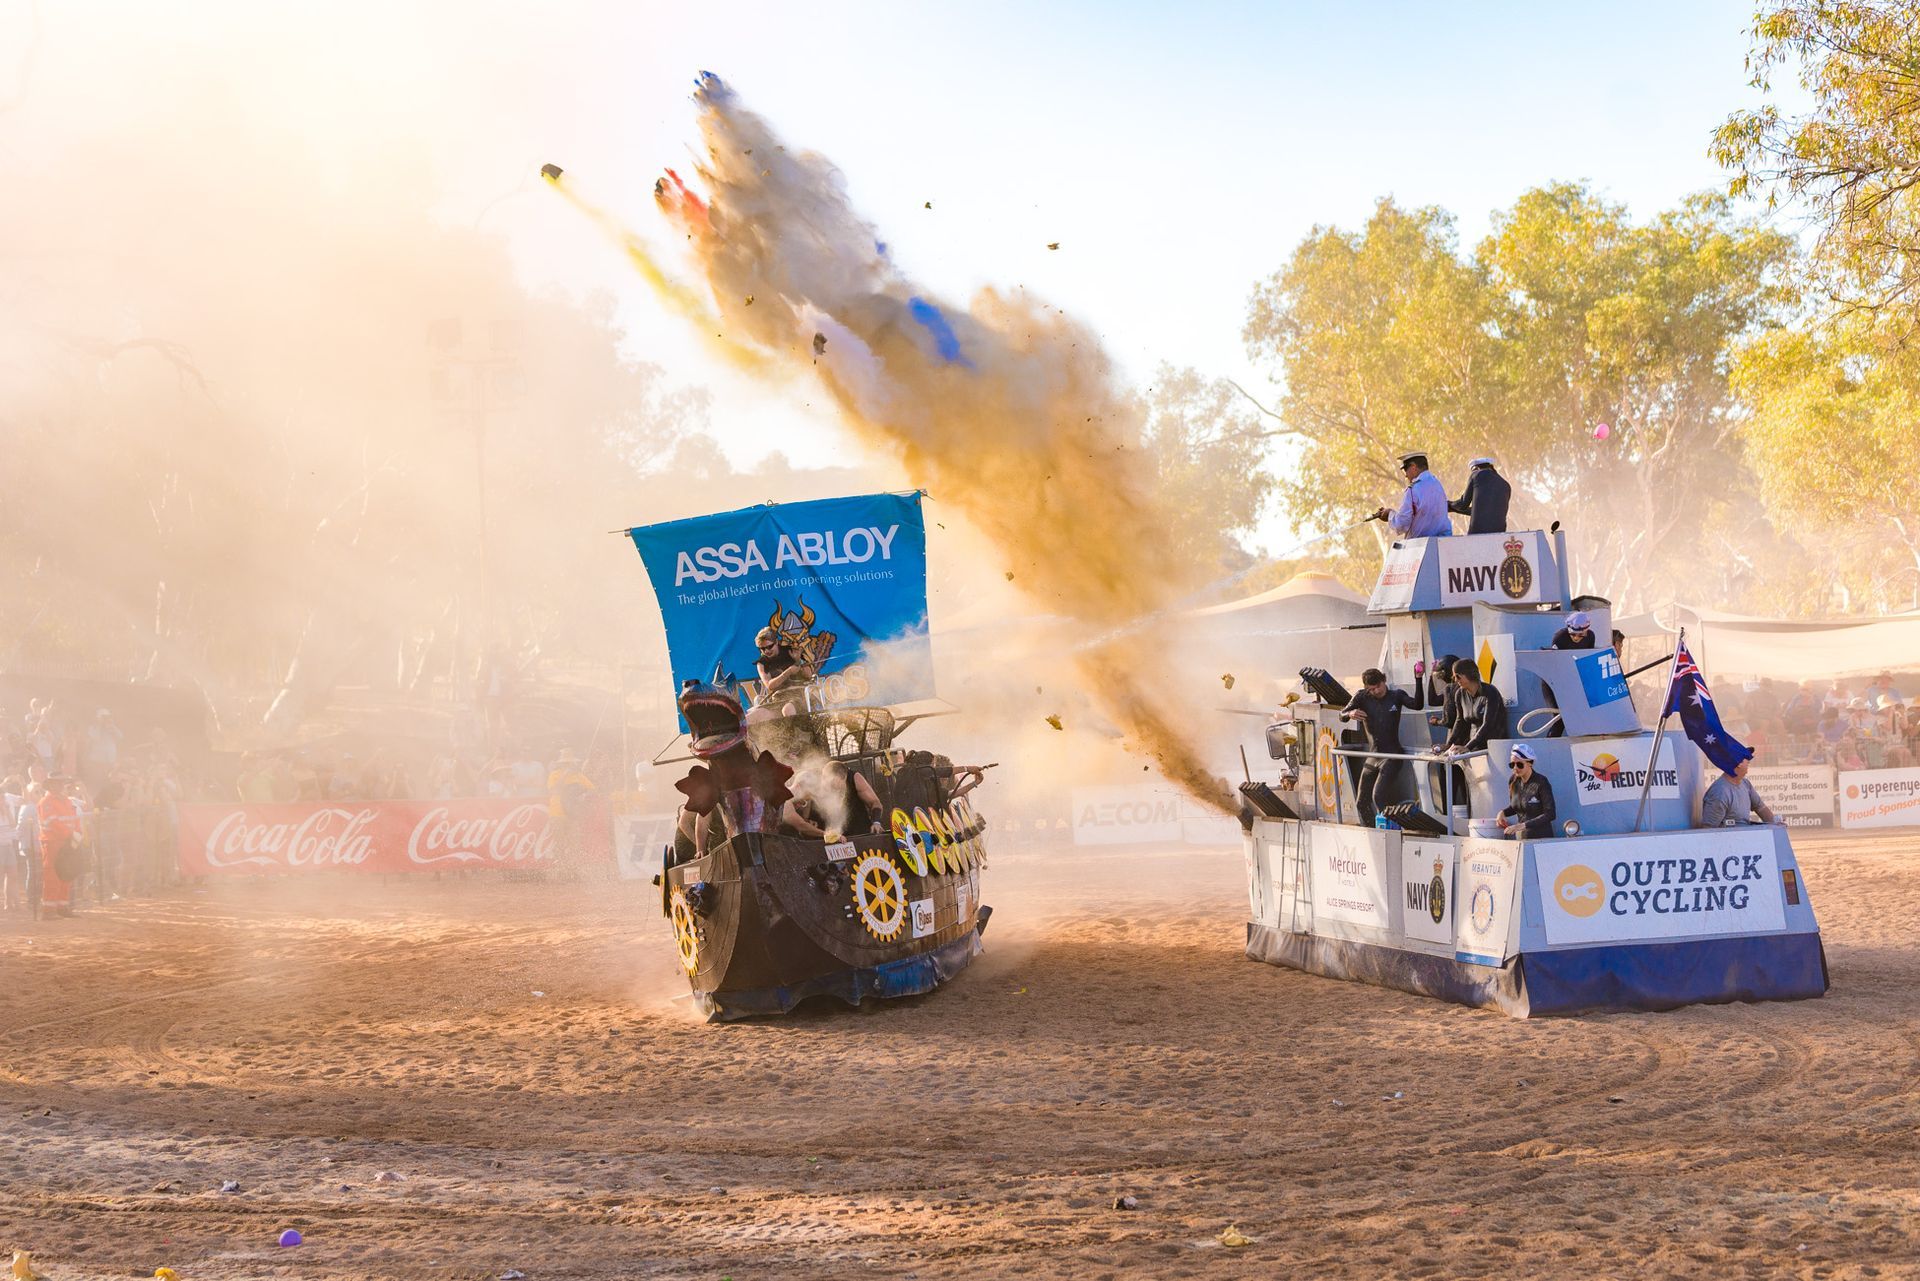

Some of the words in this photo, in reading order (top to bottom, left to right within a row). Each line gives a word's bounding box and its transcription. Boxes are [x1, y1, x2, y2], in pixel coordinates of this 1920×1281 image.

[674, 539, 769, 587] ASSA
[775, 524, 900, 570] ABLOY
[677, 594, 696, 606] The
[697, 588, 729, 605] global
[730, 583, 760, 597] leader
[761, 581, 772, 591] in
[773, 577, 798, 590] door
[800, 574, 843, 588] opening
[844, 568, 894, 583] solutions
[1448, 565, 1497, 593] NAVY
[1577, 769, 1594, 783] Do
[1584, 781, 1602, 791] the
[1755, 783, 1788, 792] ergency
[1791, 781, 1828, 790] Beacons
[1778, 792, 1815, 802] Systems
[1861, 780, 1920, 799] yeperenye
[1079, 800, 1178, 828] AECOM
[1847, 806, 1875, 821] Proud
[205, 808, 380, 867] Coca-Cola
[1329, 855, 1367, 876] Mercure
[1472, 863, 1501, 875] MBANTUA
[1611, 855, 1762, 887] OUTBACK
[1406, 881, 1429, 911] NAVY
[1610, 884, 1750, 915] CYCLING
